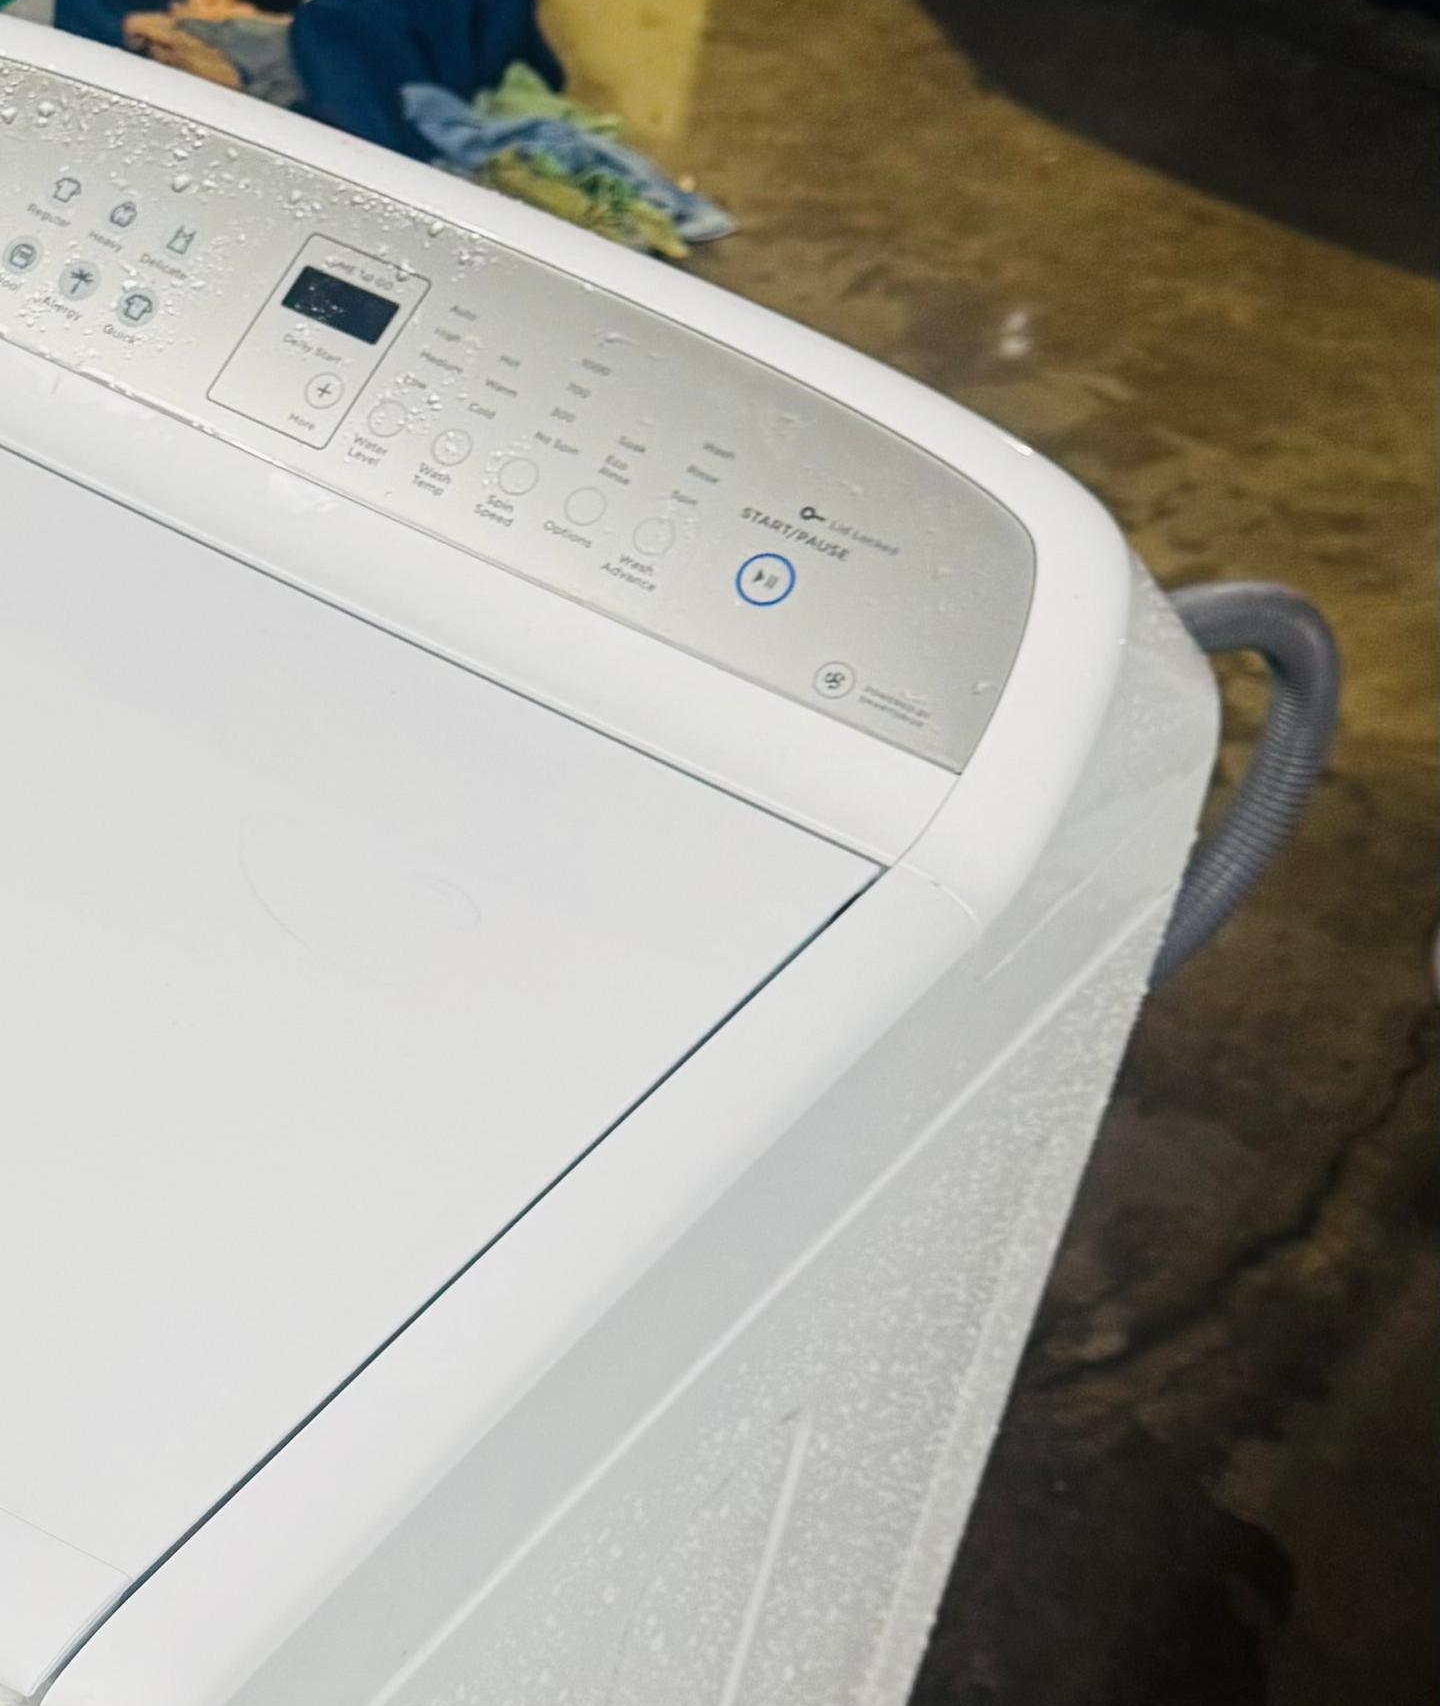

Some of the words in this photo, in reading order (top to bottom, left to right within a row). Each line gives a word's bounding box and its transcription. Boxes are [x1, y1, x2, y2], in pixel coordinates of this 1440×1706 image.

[27, 202, 70, 227] Regular
[88, 230, 123, 253] Heavy
[140, 253, 189, 281] Delicate
[103, 324, 142, 344] Quick
[315, 347, 343, 364] Start
[288, 413, 316, 430] More
[347, 447, 381, 467] Level
[353, 434, 388, 457] Water
[412, 474, 445, 496] Temp
[418, 462, 451, 485] Wash
[474, 503, 514, 527] Speed
[487, 495, 515, 514] Spin
[544, 519, 592, 549] Options
[740, 506, 851, 562] START/PAUSE
[600, 562, 657, 592] Advance
[619, 555, 654, 576] Wash
